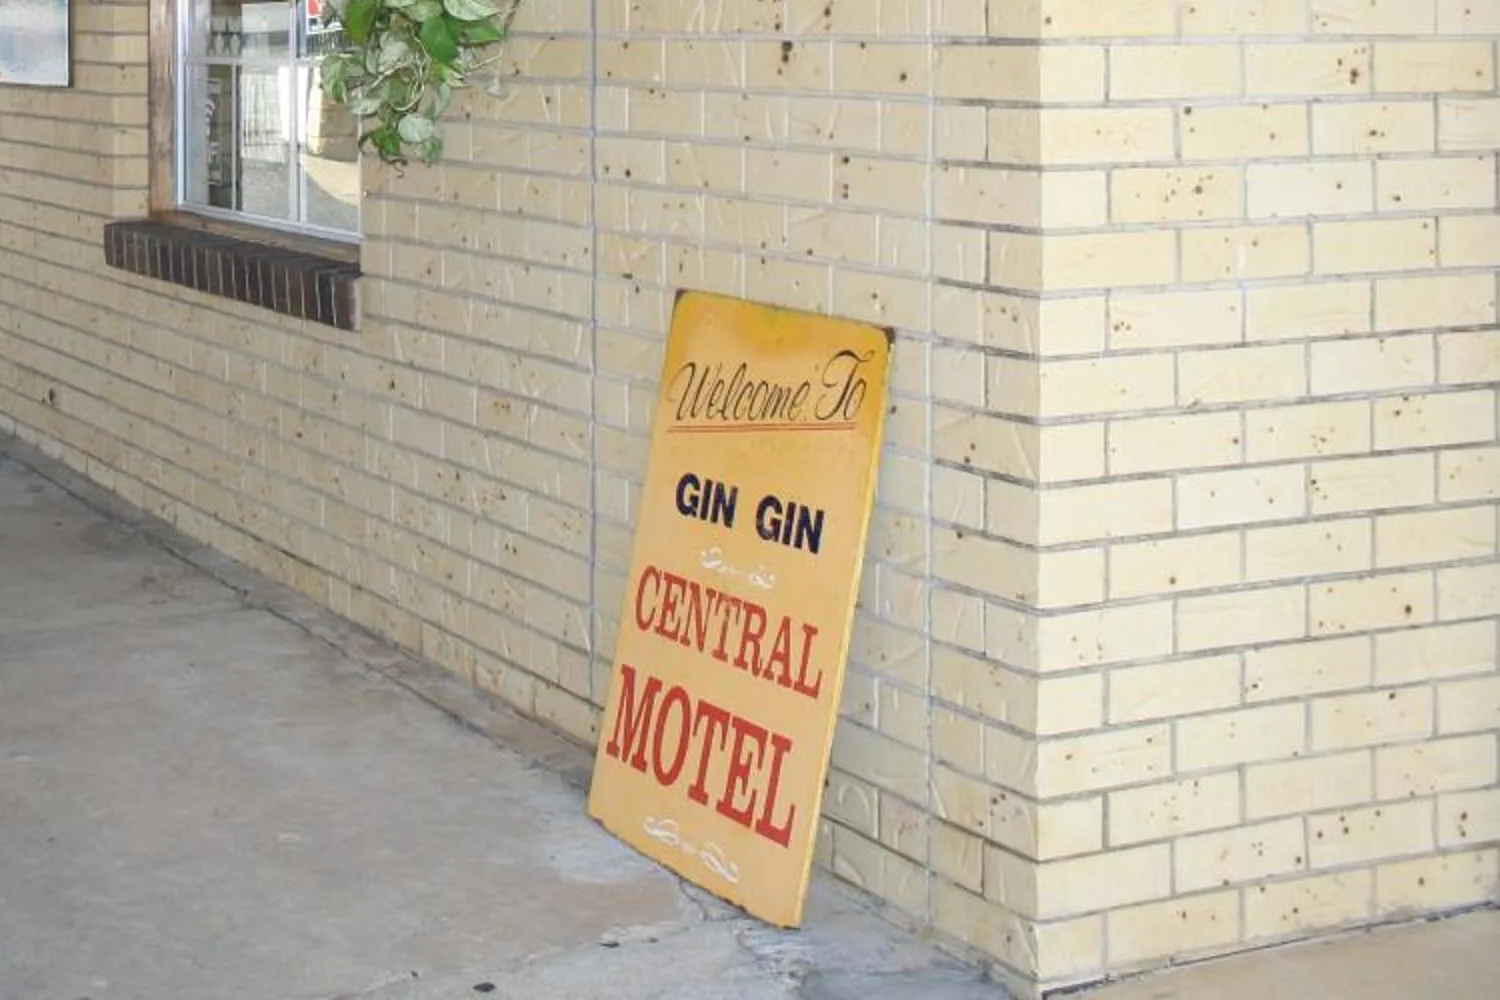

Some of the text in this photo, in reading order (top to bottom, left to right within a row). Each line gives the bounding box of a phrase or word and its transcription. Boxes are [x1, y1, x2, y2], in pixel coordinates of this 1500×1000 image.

[668, 349, 875, 421] Welcome To
[675, 472, 825, 555] GIN GIN
[635, 565, 823, 699] CENTRAL
[605, 663, 796, 848] MOTEL
